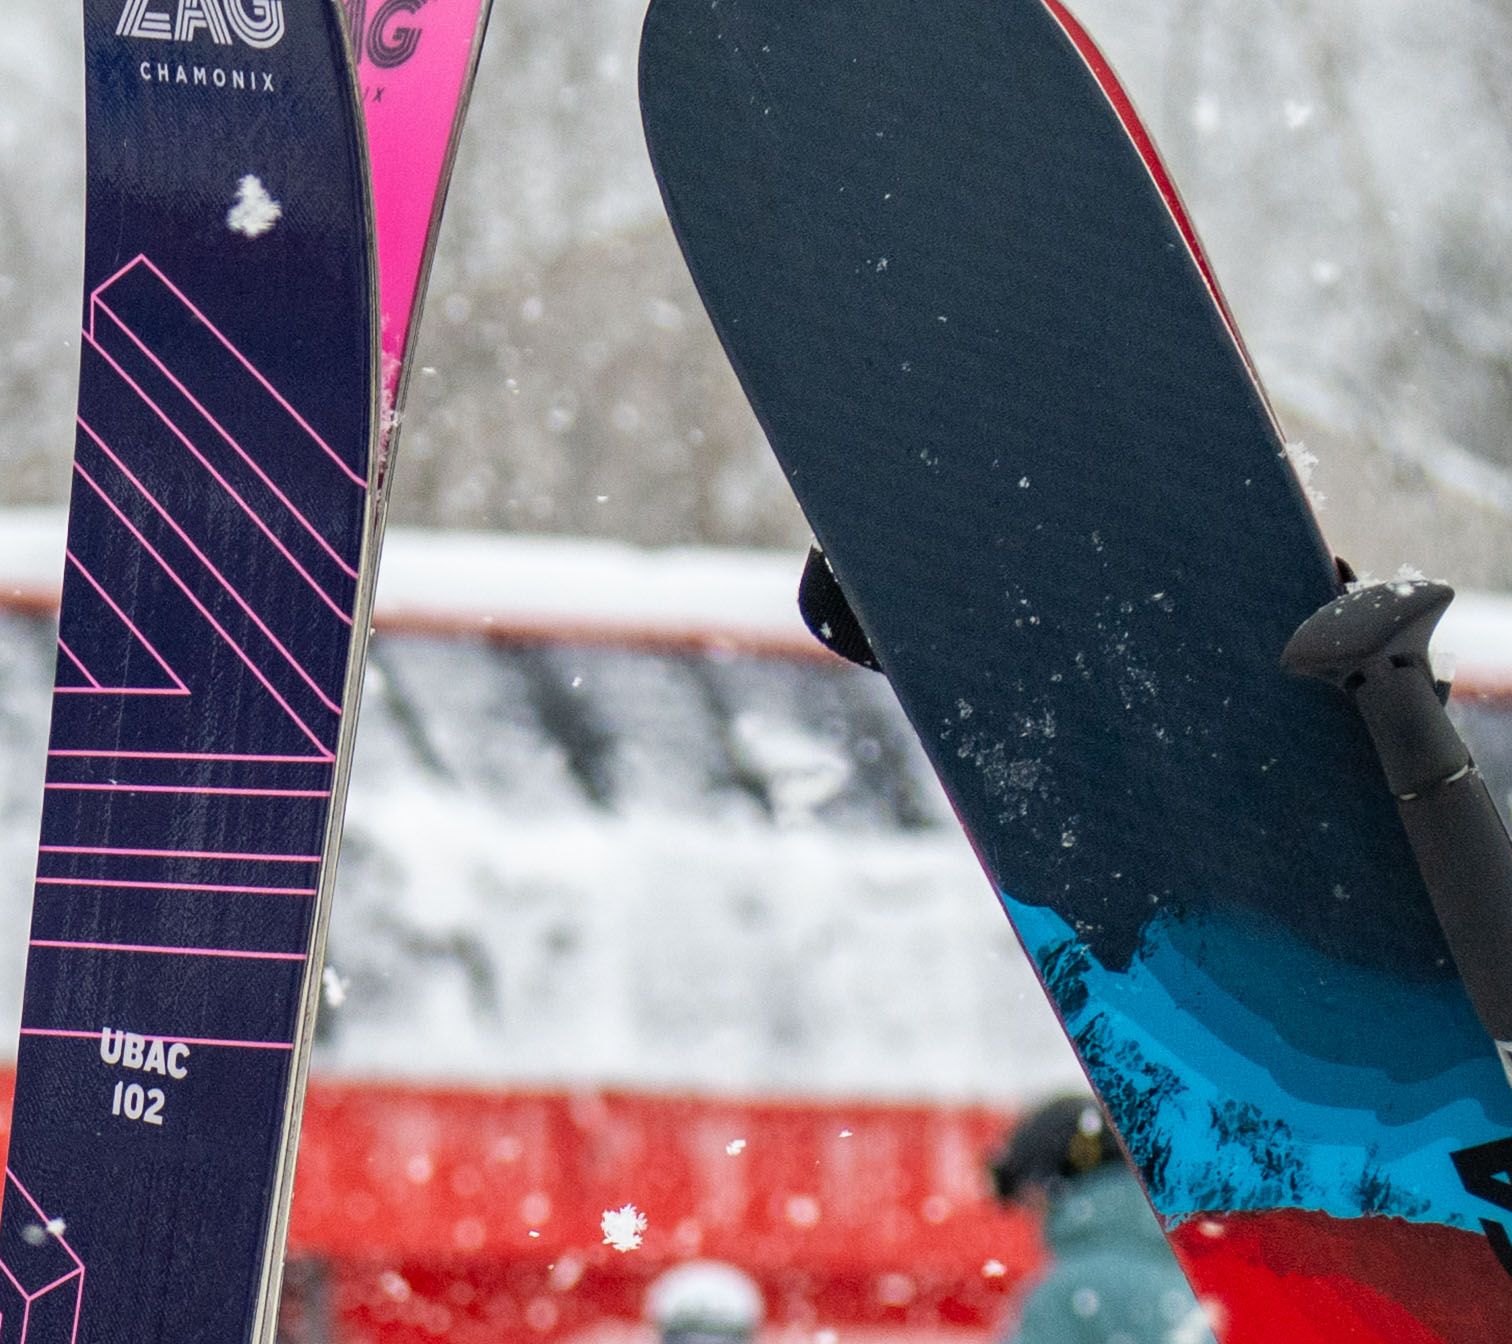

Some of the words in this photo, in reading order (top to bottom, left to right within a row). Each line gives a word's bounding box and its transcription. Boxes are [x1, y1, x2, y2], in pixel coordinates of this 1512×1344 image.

[139, 61, 275, 93] CHAMONIX
[99, 1026, 191, 1080] UBAC
[111, 1080, 165, 1125] 102
